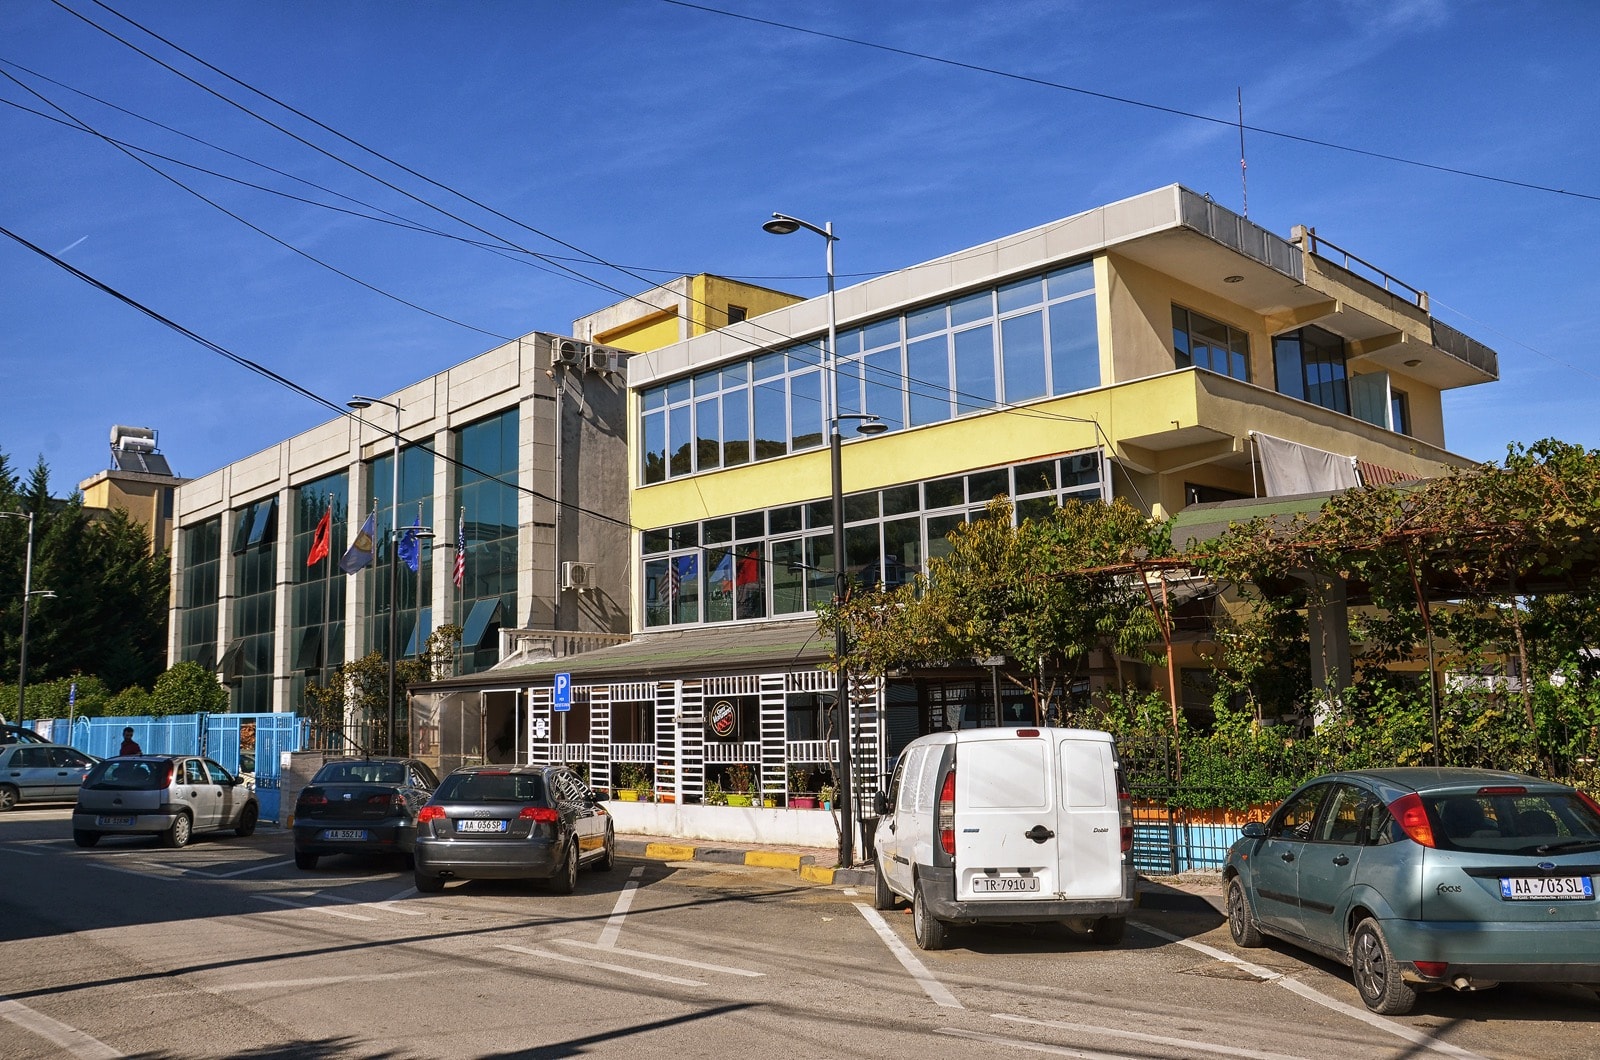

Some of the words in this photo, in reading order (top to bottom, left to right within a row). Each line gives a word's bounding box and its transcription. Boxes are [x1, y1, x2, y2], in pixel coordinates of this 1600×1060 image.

[557, 675, 567, 694] P
[464, 820, 474, 829] AA
[330, 830, 339, 838] AA
[1029, 879, 1036, 890] J
[1515, 880, 1531, 894] AA
